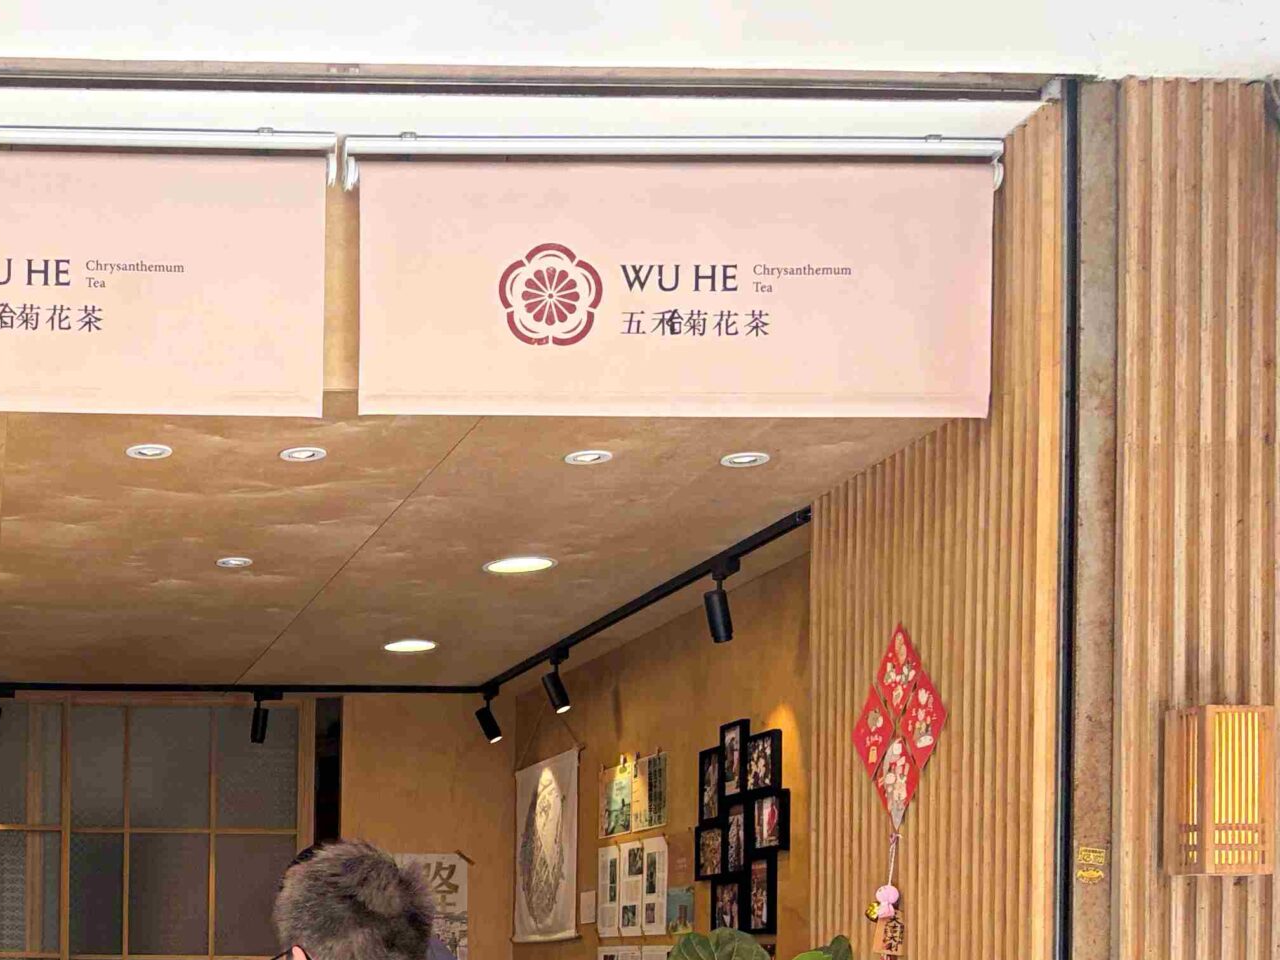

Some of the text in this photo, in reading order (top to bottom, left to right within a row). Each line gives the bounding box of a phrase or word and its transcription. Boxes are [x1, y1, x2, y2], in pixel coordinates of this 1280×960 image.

[25, 258, 71, 286] HE
[85, 260, 185, 274] Chrysanthemum
[620, 264, 852, 292] WU HE Chrysanthemum
[86, 277, 106, 288] Tea
[752, 282, 773, 293] Tea
